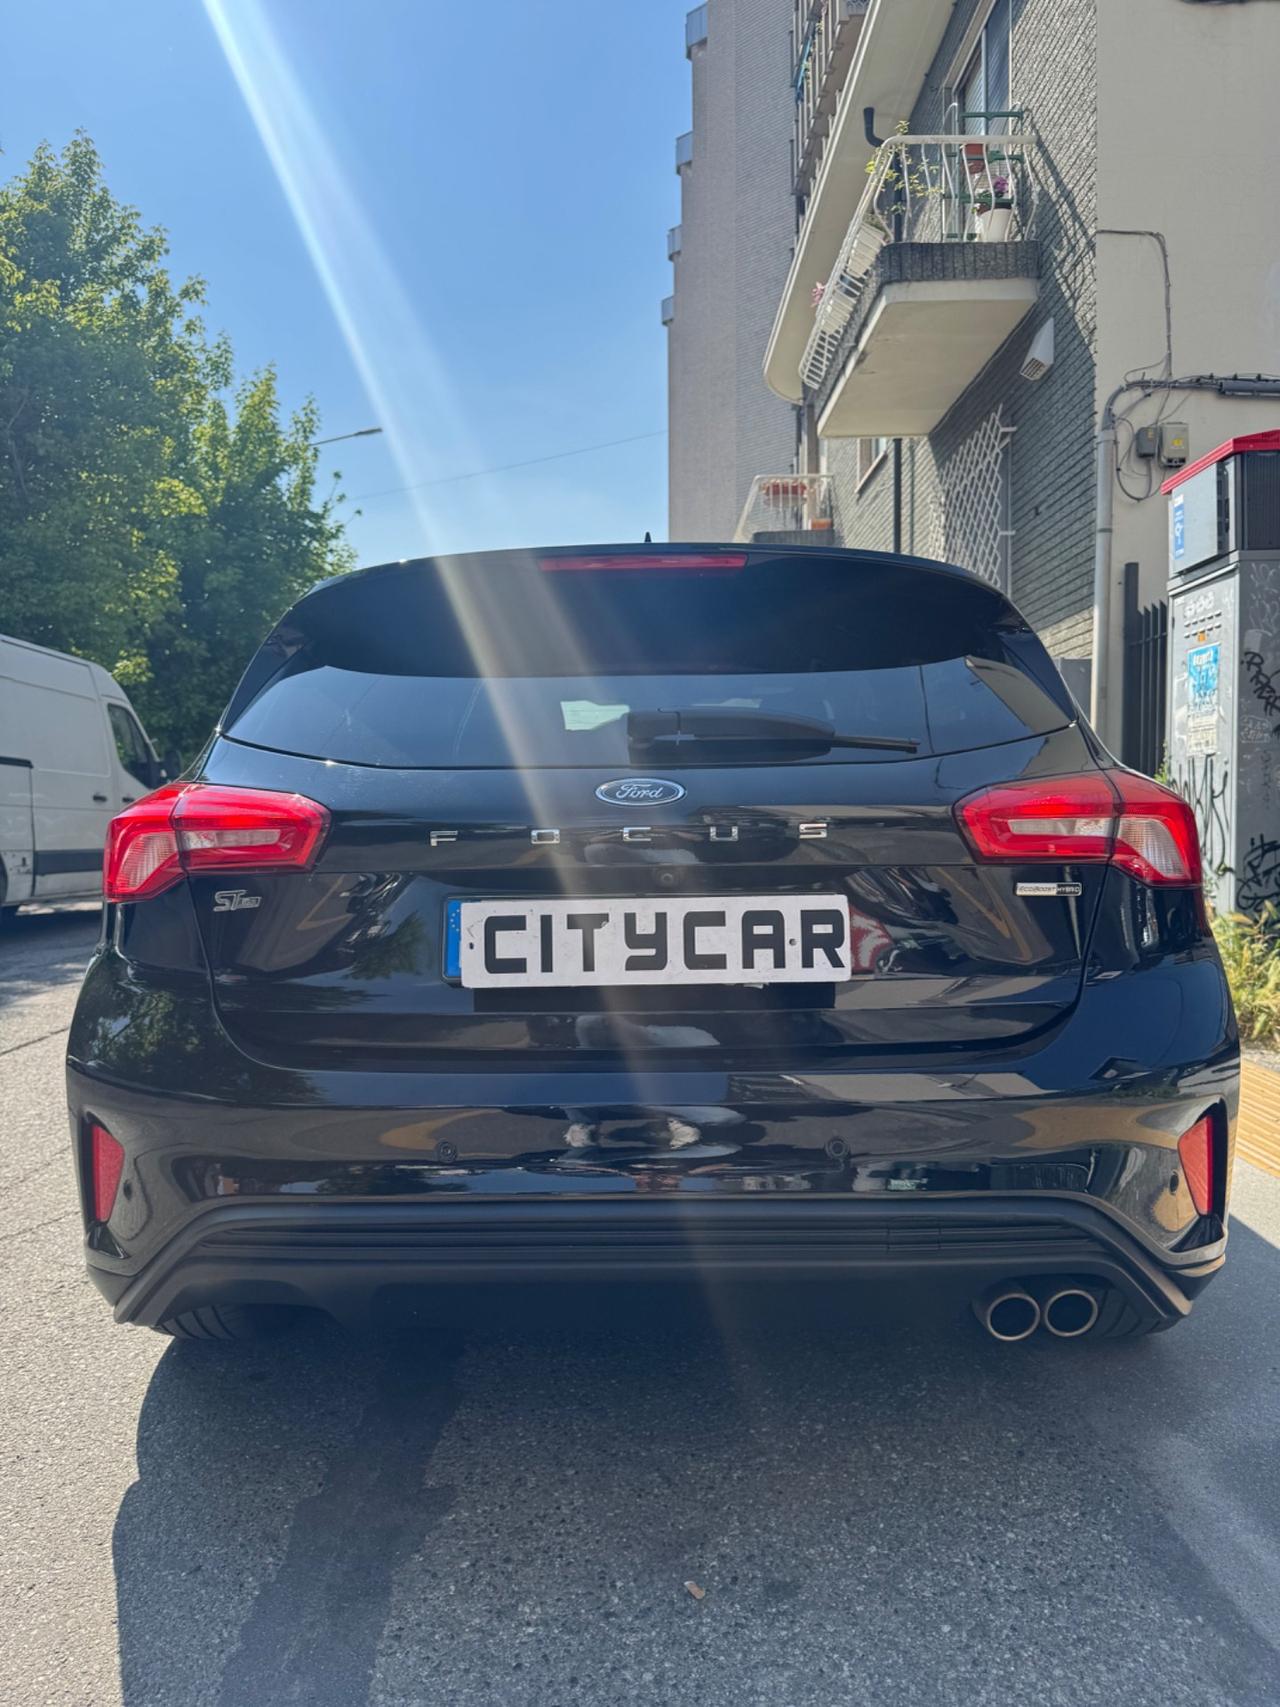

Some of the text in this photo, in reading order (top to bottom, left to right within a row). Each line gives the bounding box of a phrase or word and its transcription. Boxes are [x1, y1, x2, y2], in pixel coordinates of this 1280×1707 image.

[616, 783, 663, 800] Ford
[430, 823, 828, 846] FOCUS
[484, 909, 846, 974] CITYCAR
